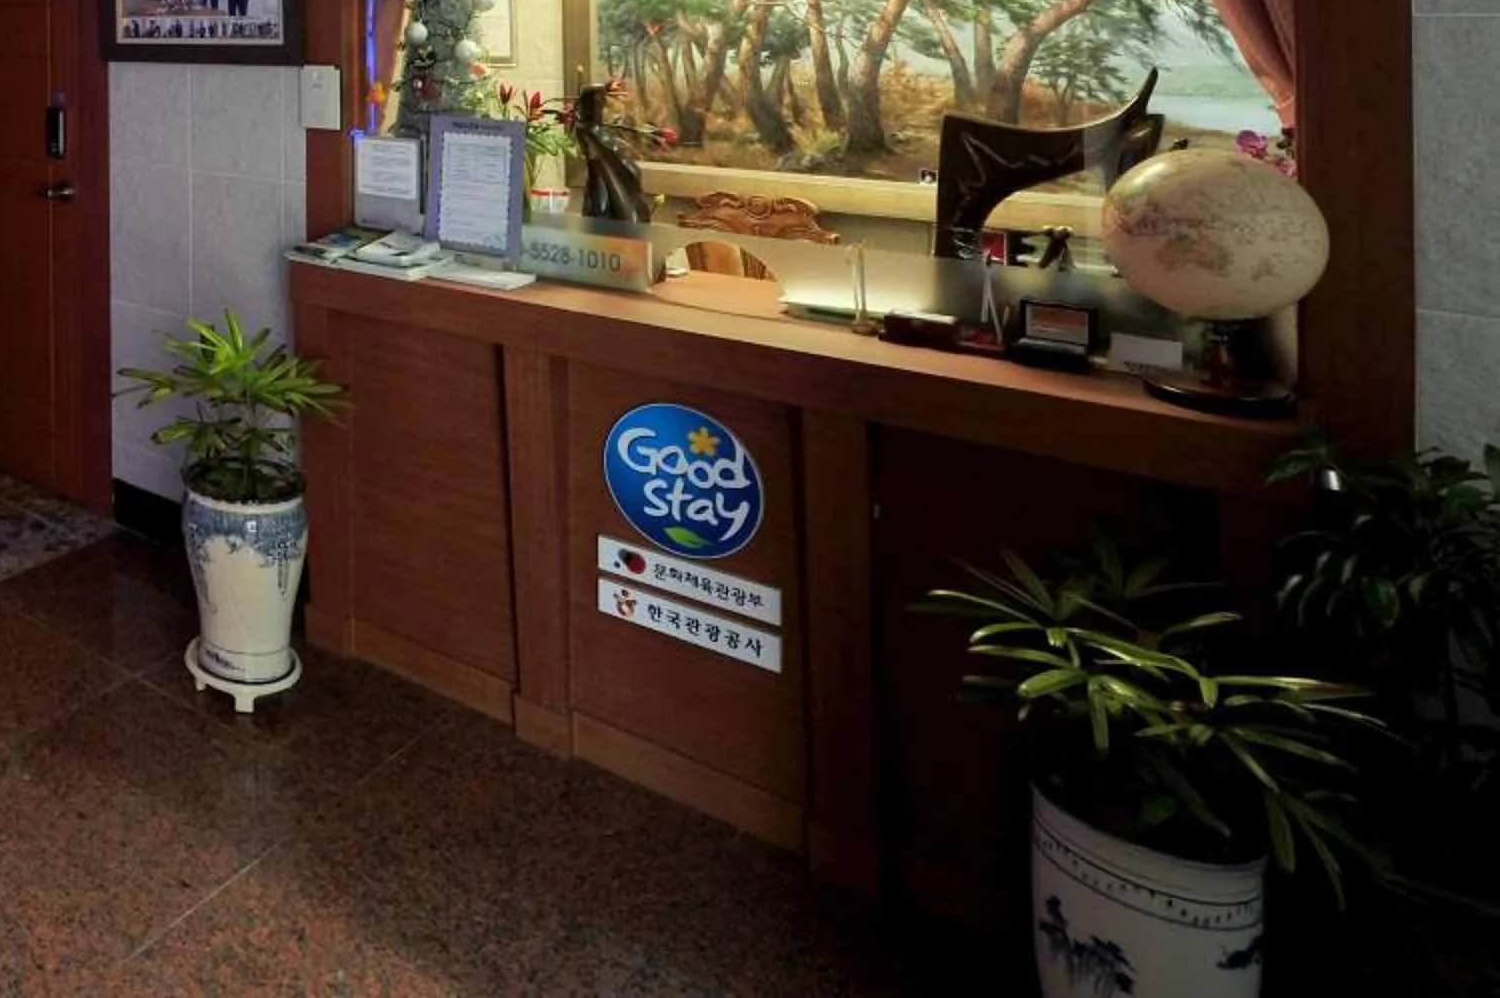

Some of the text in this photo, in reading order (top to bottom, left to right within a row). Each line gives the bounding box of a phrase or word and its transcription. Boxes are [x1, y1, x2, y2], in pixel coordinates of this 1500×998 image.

[519, 241, 621, 273] -5528-1010
[617, 427, 752, 489] Good
[643, 478, 750, 542] stay
[653, 563, 764, 608] 문화체육관광부
[647, 603, 764, 658] 한국관광공사
